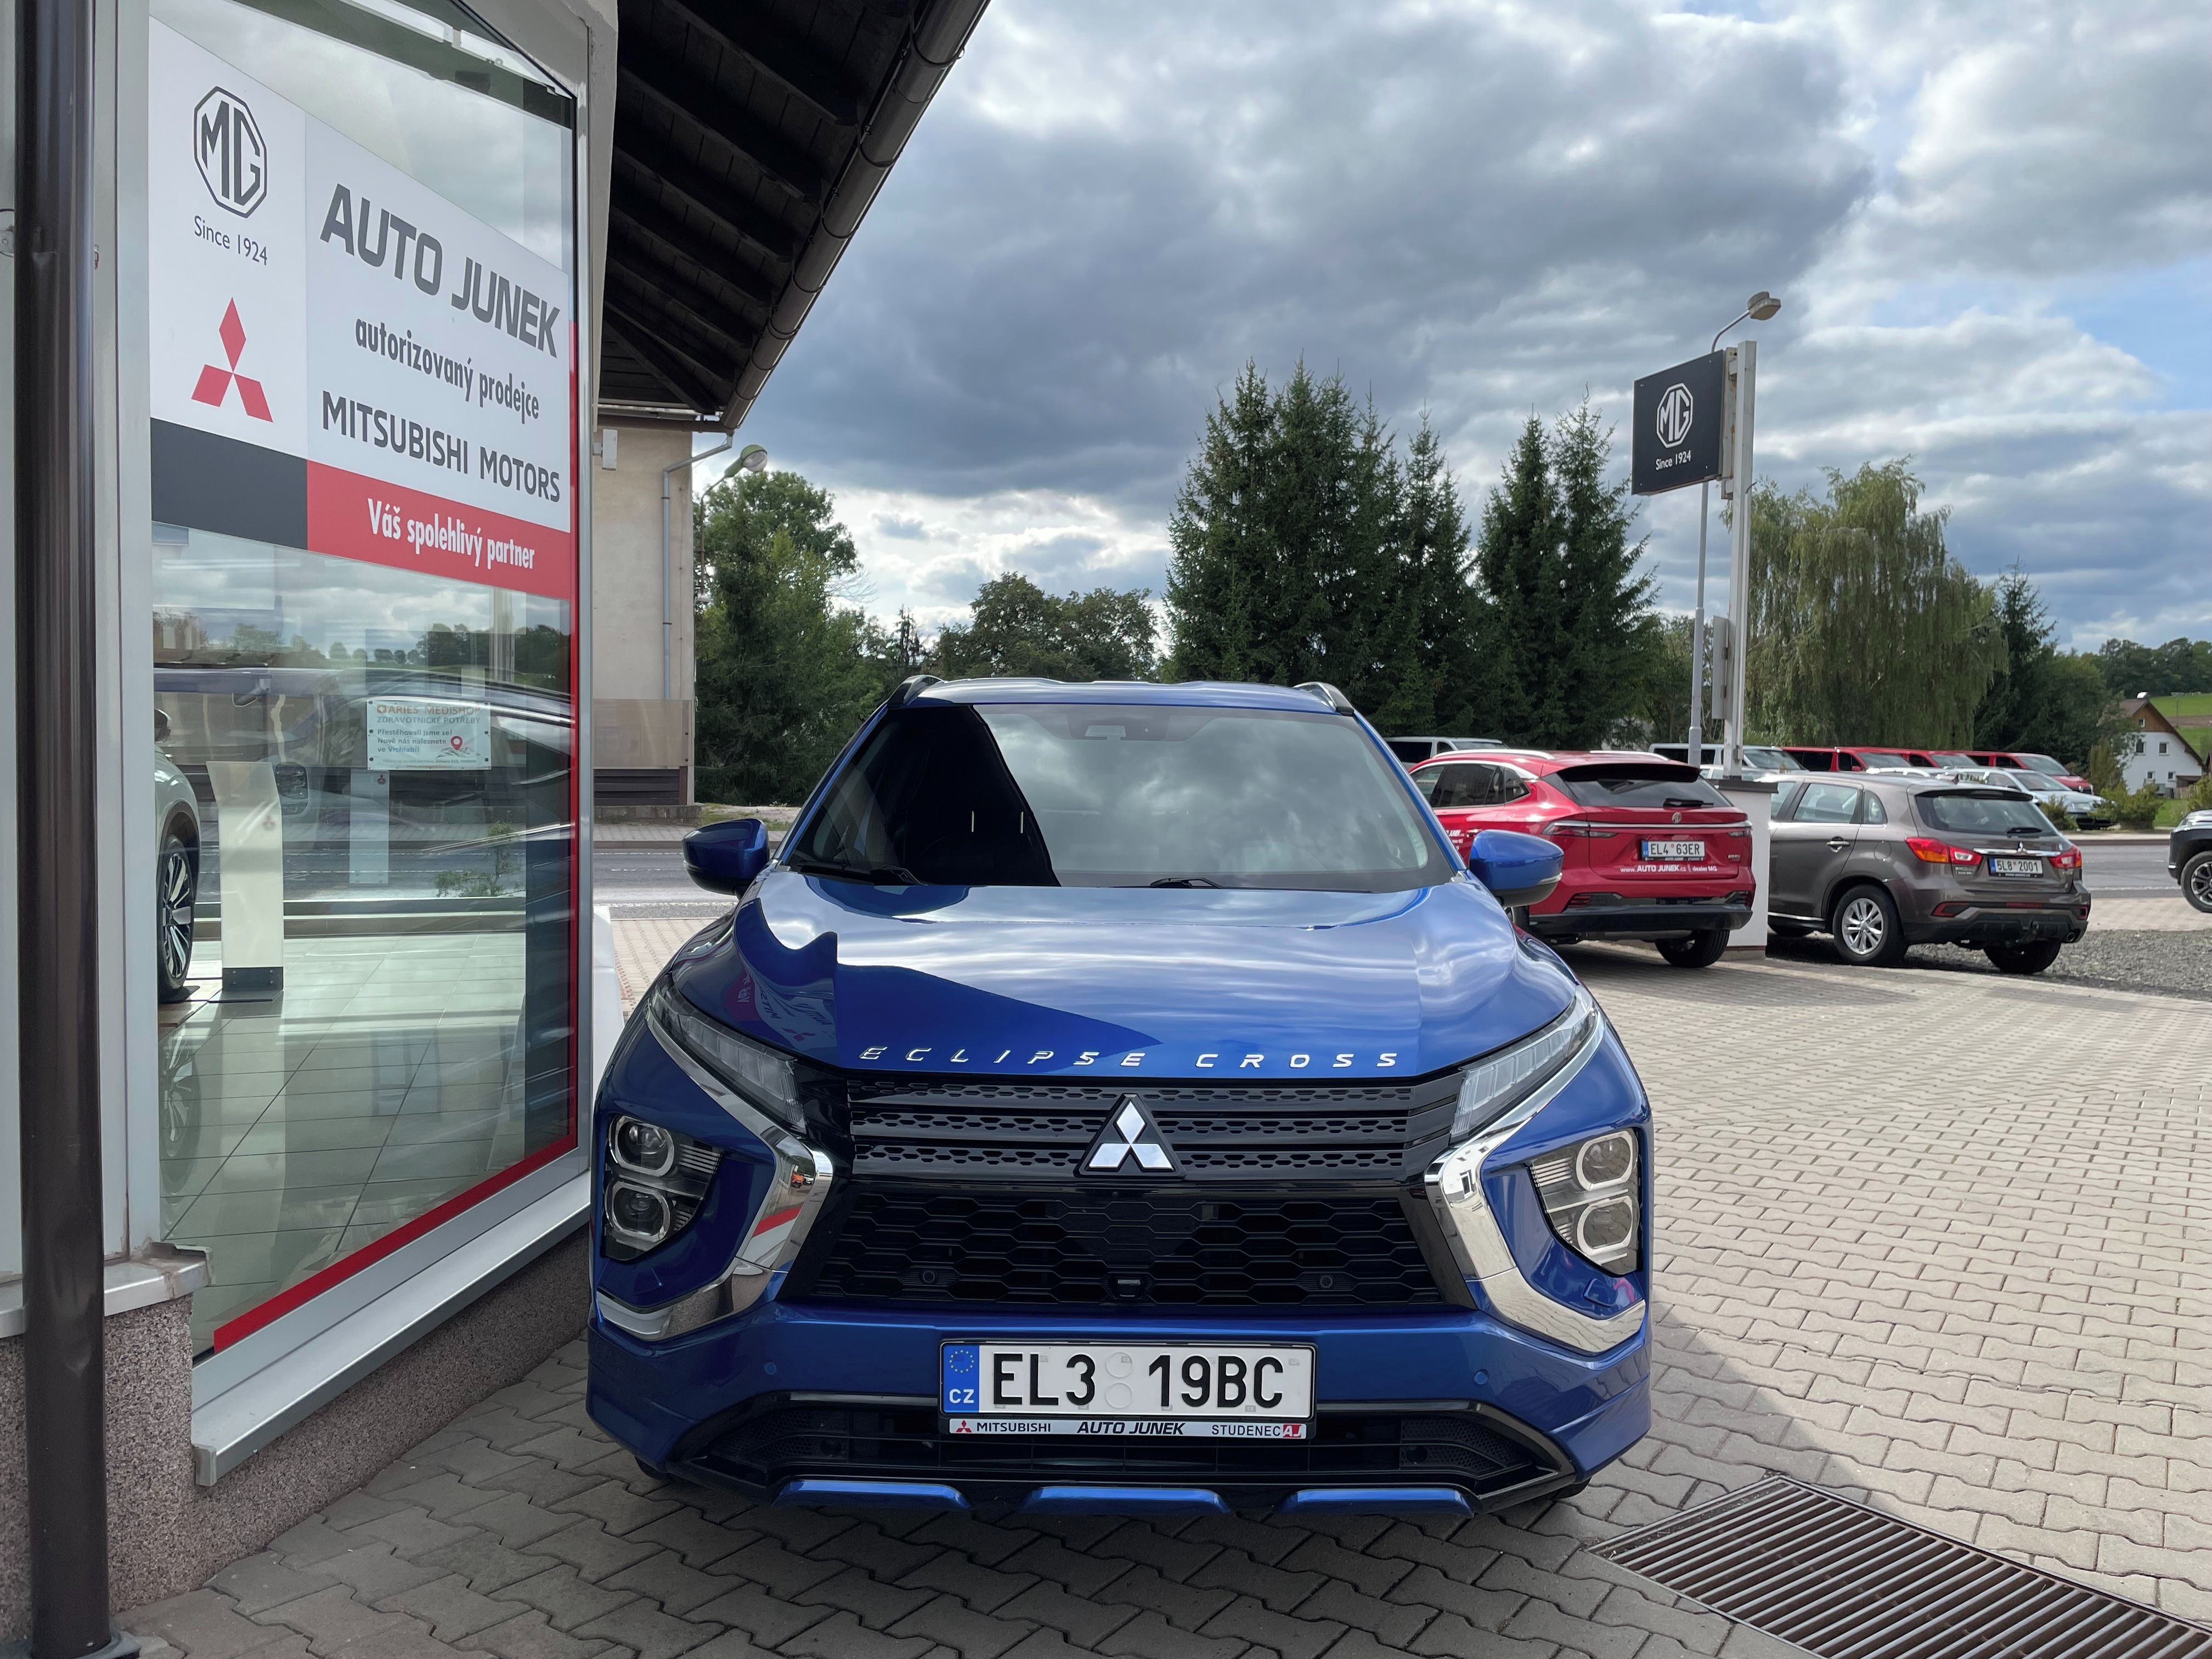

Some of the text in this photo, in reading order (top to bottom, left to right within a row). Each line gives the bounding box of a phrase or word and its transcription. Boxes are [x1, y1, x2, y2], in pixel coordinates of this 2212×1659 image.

[201, 100, 261, 206] MG
[194, 216, 268, 266] Since 1924
[320, 183, 560, 358] AUTO JUNEK
[356, 318, 539, 424] autorizovaný prodejce
[1660, 389, 1690, 442] MG
[323, 391, 560, 503] MITSUBISHI MOTORS
[1656, 450, 1691, 470] Since 1924
[368, 498, 535, 569] Váš spolehlivý partner
[389, 706, 481, 715] ARIES MEDISHOP
[1650, 843, 1700, 855] EL4 63ER
[1997, 860, 2038, 872] 5L8 2001
[860, 1046, 1398, 1069] ECLIPSE CROSS
[949, 1389, 974, 1404] CZ
[993, 1353, 1284, 1408] EL3 19BC
[977, 1421, 1281, 1436] MITSUBISHI AUTO JUNEK STUDENEC
